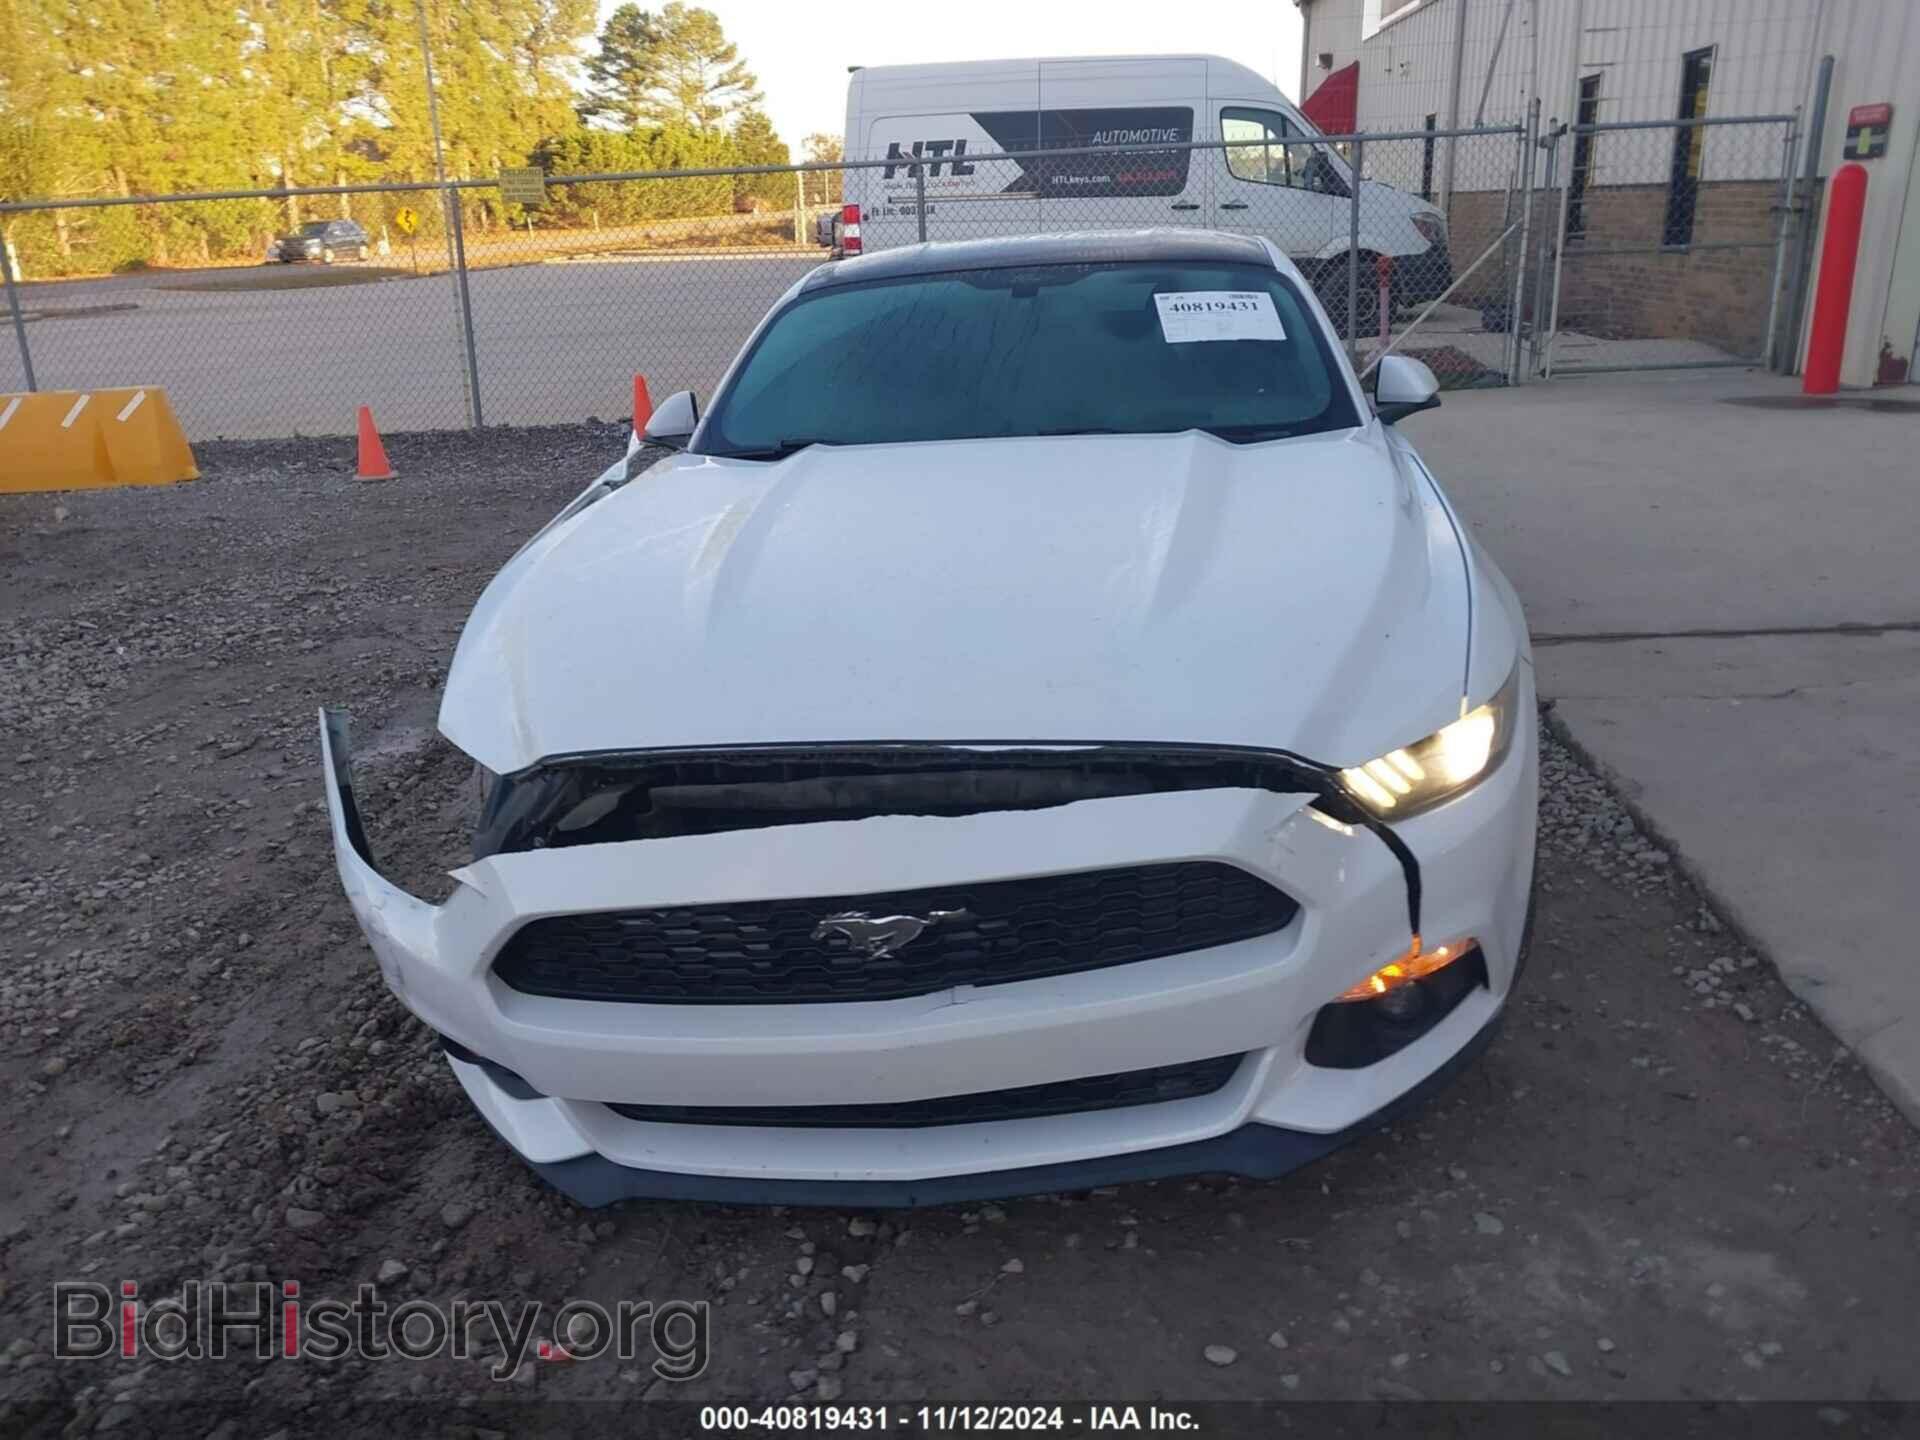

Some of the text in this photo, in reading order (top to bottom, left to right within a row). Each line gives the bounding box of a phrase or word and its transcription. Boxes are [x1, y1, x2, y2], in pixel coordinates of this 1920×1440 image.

[1092, 128, 1179, 144] AUTOMOTIVE
[884, 139, 975, 179] HTL
[1169, 301, 1259, 312] 40819431
